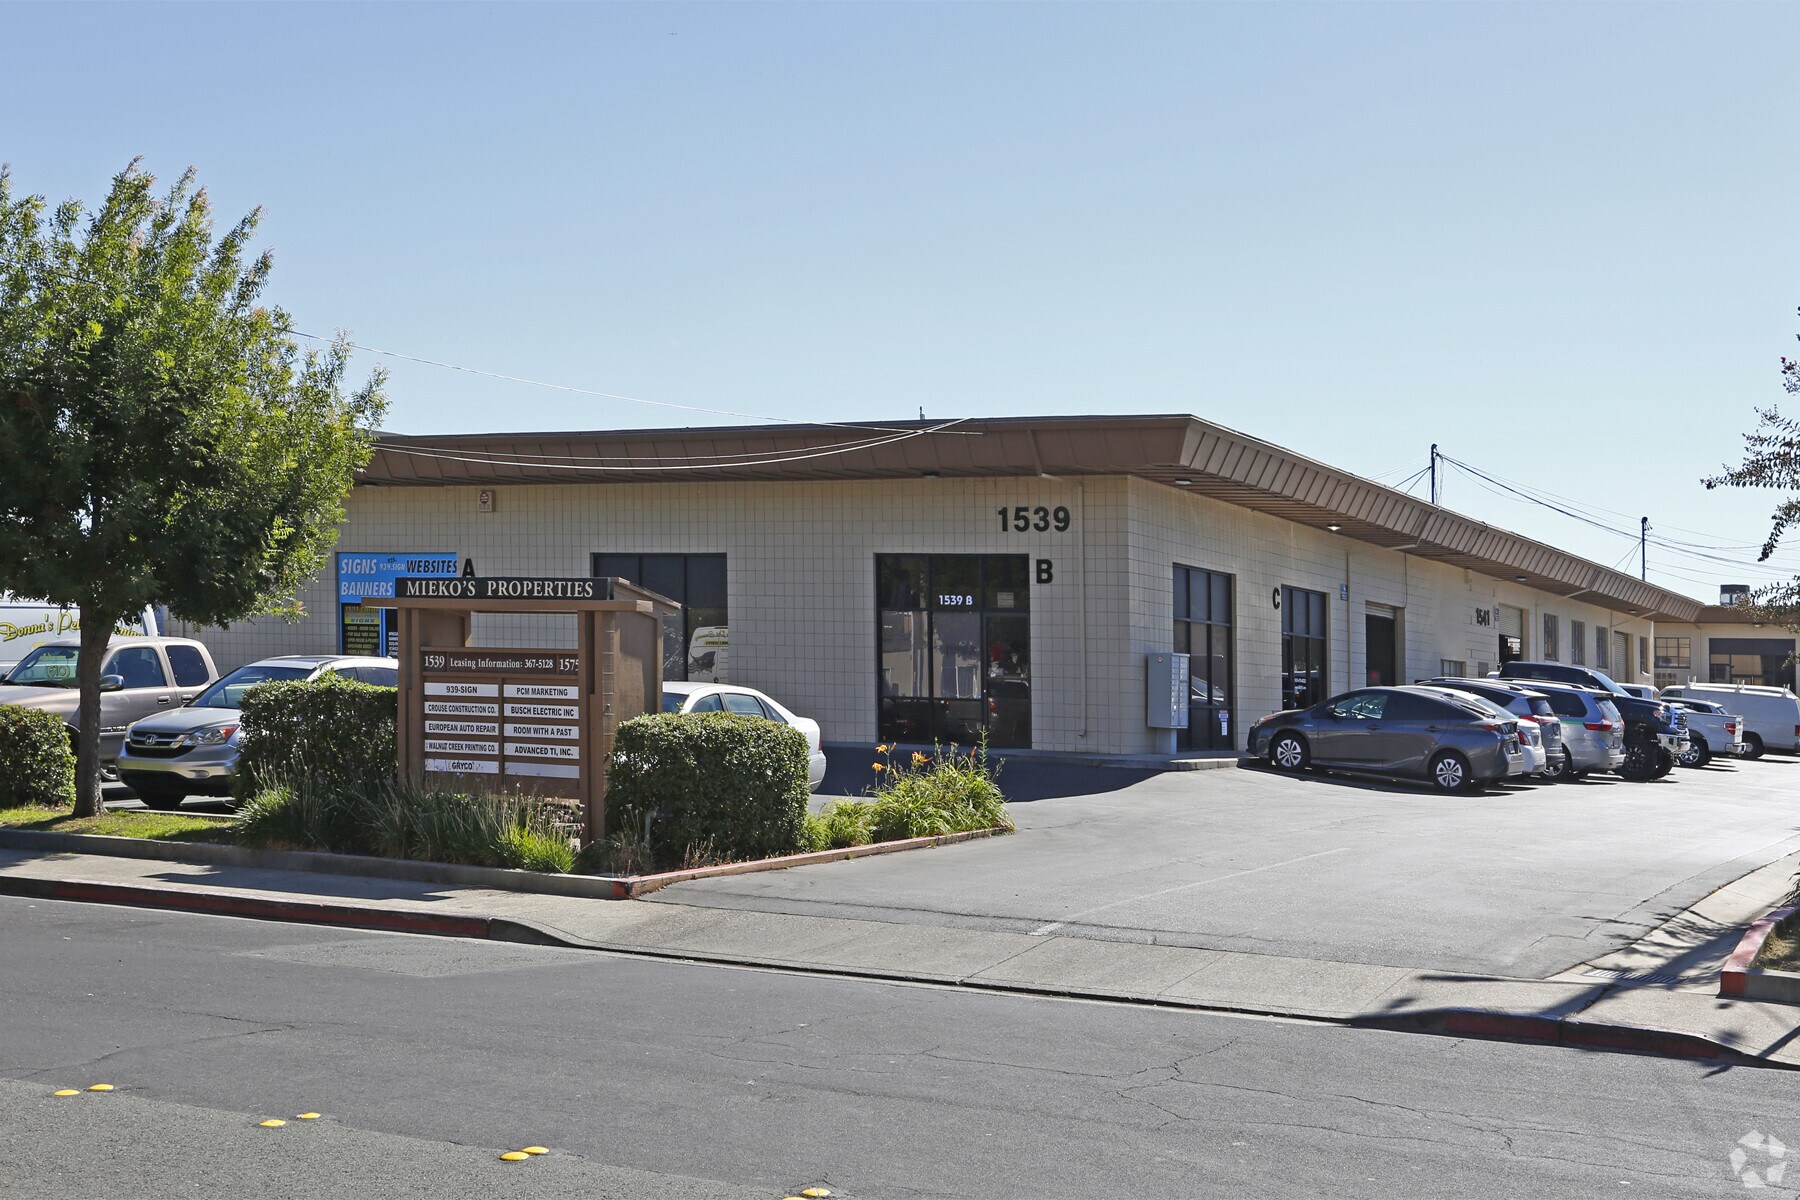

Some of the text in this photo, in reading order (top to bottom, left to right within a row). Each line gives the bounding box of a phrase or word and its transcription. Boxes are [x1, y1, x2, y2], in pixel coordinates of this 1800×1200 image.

[998, 506, 1070, 532] 1539
[341, 559, 377, 574] SIGNS
[406, 560, 457, 574] WEBSITES
[462, 558, 476, 578] A
[1036, 559, 1053, 584] B
[341, 581, 393, 596] BANNERS
[406, 580, 593, 598] MIEKO'S PROPERTIES
[938, 595, 973, 606] 1539 B
[1272, 587, 1280, 610] C
[1476, 607, 1490, 626] 1541
[0, 613, 54, 642] Donna's
[424, 655, 445, 668] 1539
[450, 657, 554, 670] Leasing Information: 367-5128
[559, 659, 579, 671] 1575
[446, 685, 478, 694] 939-SIGN
[516, 687, 568, 697] PCM MARKETING
[428, 704, 496, 714] CROUSE CONSTRUCTION CO.
[511, 706, 574, 717] BUSCH ELECTRIC INC
[428, 723, 496, 733] EUROPEAN AUTO REPAIR
[513, 726, 572, 737] ROOM WITH A PAST
[428, 742, 448, 750] WALNUT
[448, 743, 464, 751] CREEK
[464, 744, 487, 752] PRINTING
[514, 746, 549, 755] ADVANCED
[559, 748, 574, 756] INC.
[452, 761, 473, 770] GRYCO
